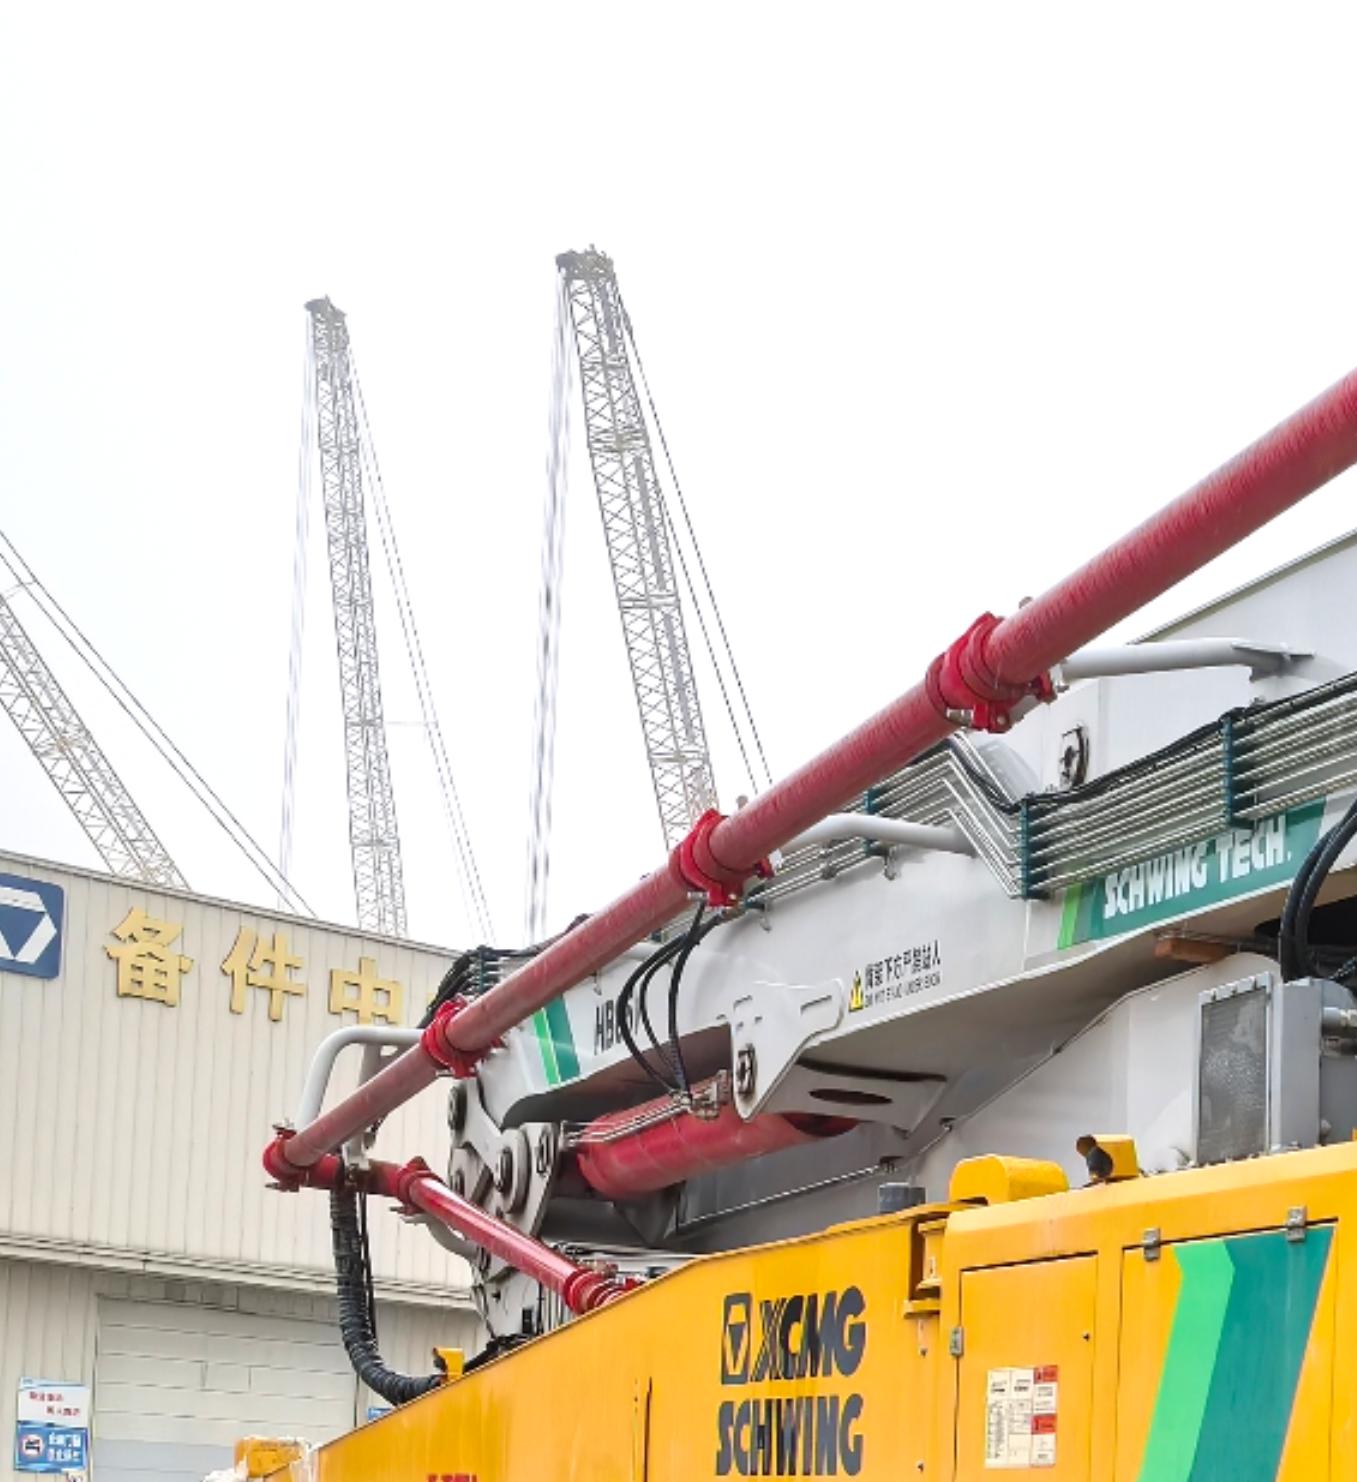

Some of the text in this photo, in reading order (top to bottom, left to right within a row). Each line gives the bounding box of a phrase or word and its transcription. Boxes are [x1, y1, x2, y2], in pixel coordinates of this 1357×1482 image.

[1103, 837, 1208, 919] SCHWING
[104, 906, 436, 1025] 备件中
[751, 1285, 866, 1382] XCMG
[716, 1393, 864, 1476] SCHWING
